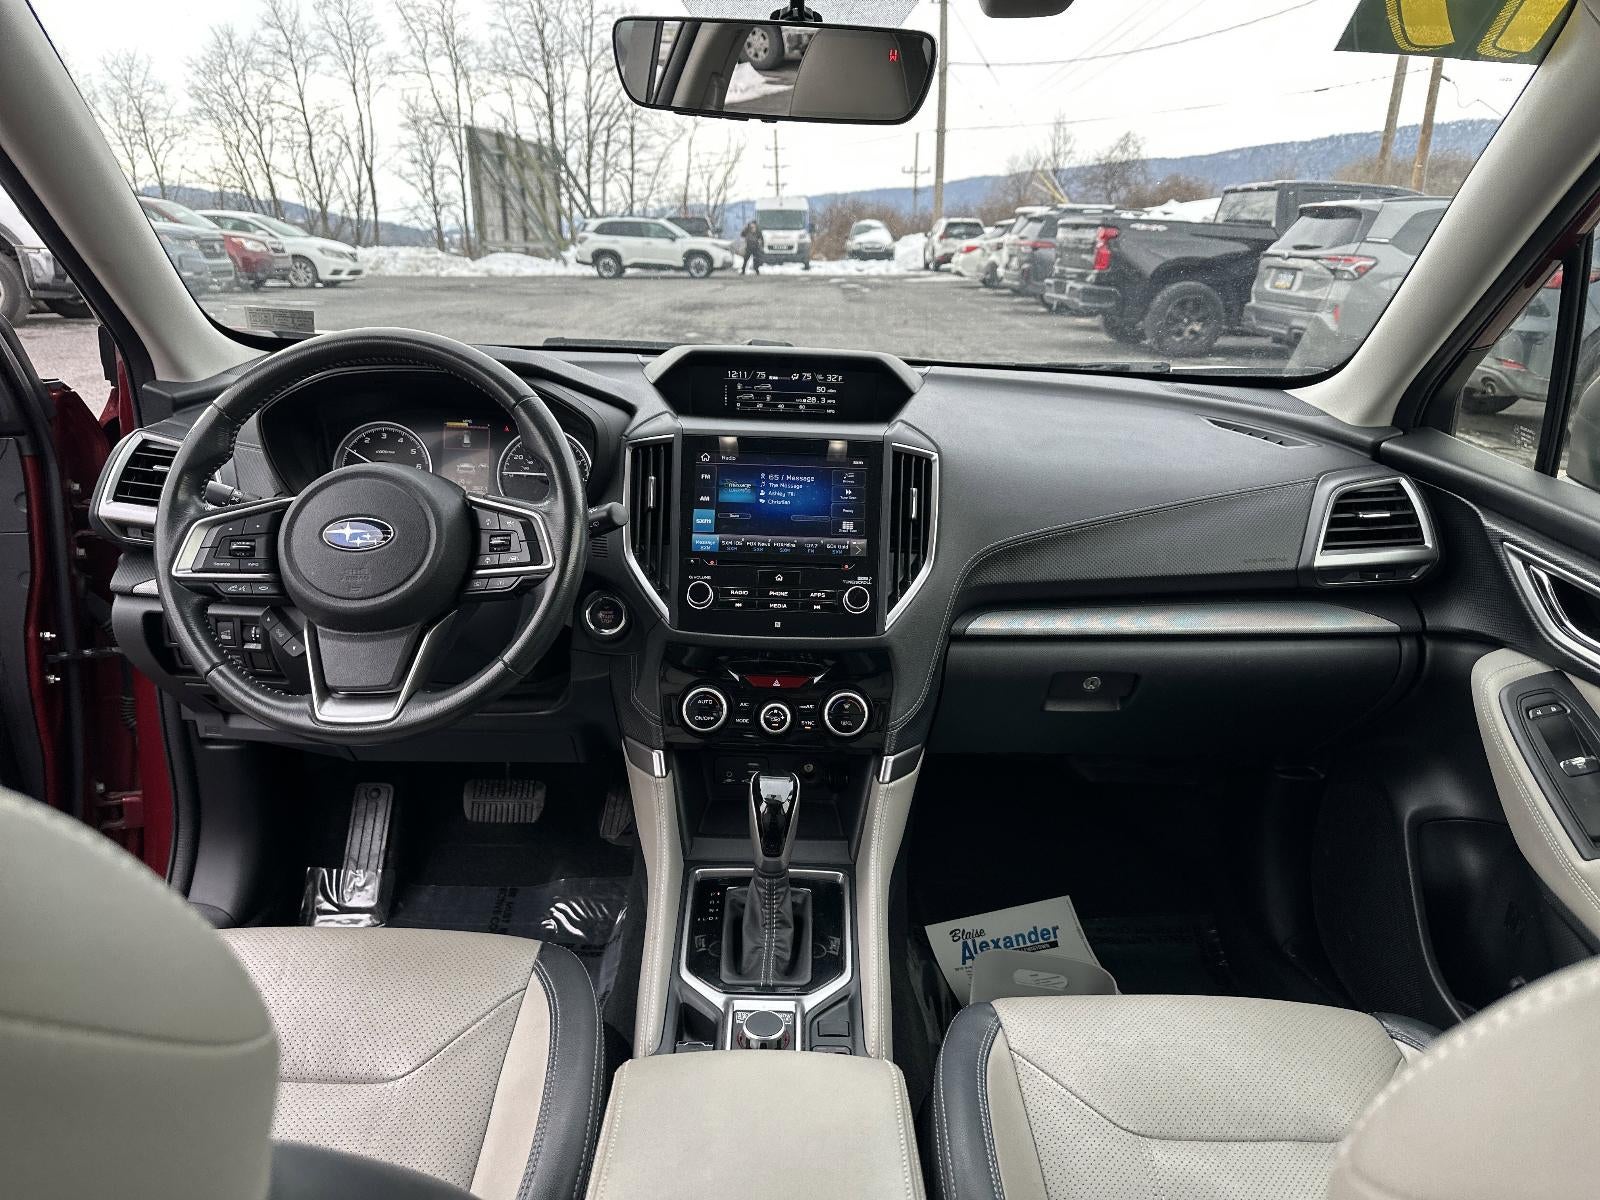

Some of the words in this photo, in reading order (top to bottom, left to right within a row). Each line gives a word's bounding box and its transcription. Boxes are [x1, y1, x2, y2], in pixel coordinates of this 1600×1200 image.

[727, 370, 747, 378] 12:11
[802, 372, 812, 380] 75
[806, 396, 826, 404] 28.3
[364, 436, 371, 444] 2
[381, 432, 387, 440] 3
[786, 475, 815, 483] Message
[949, 928, 986, 942] Blaise
[961, 924, 1060, 966] Alexander
